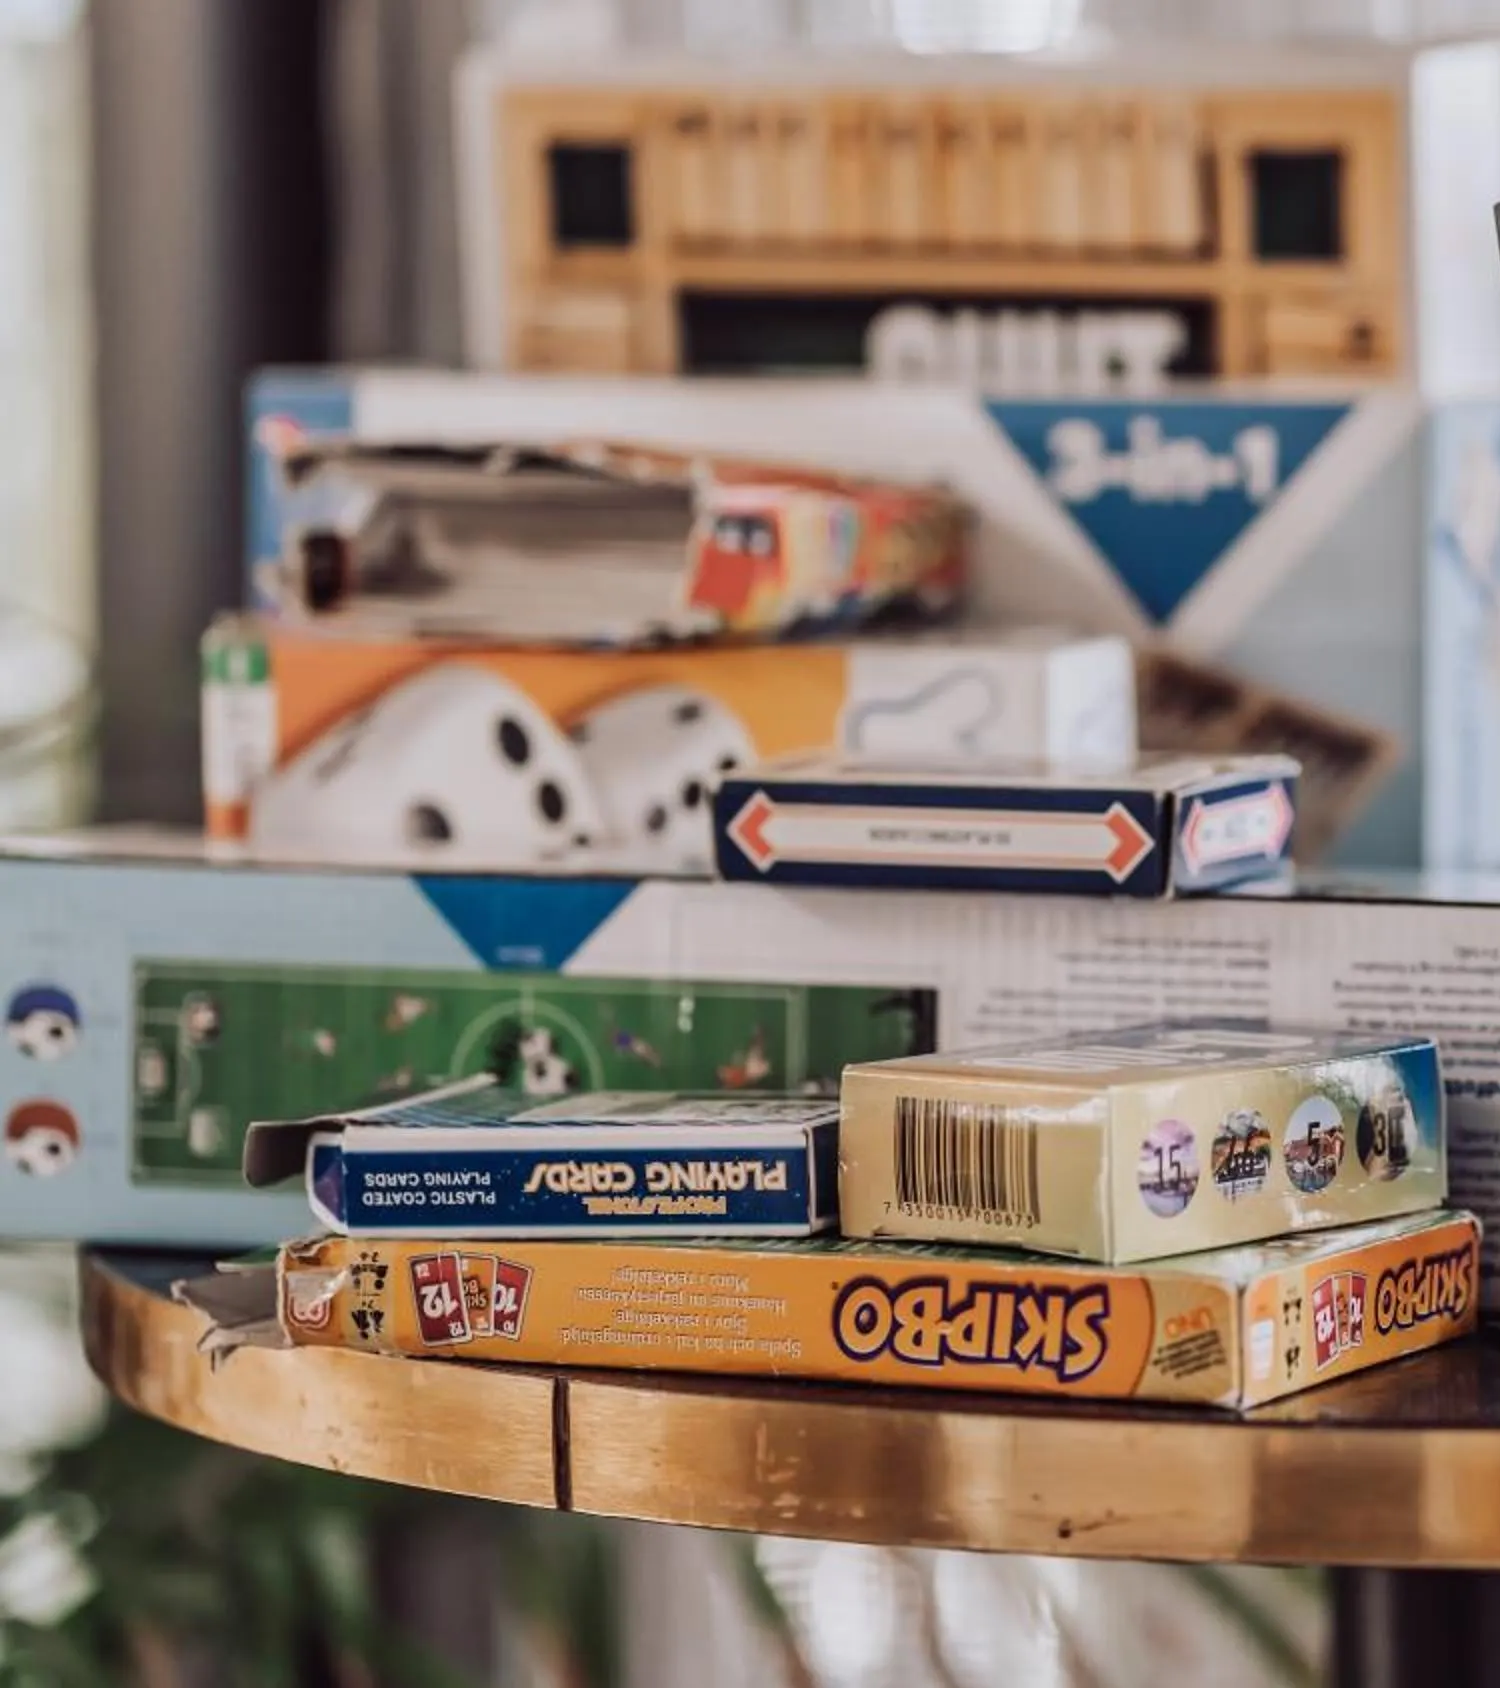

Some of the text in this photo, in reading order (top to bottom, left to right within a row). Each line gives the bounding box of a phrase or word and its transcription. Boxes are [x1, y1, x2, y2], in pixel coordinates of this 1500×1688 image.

[1046, 414, 1280, 503] 3-in-1
[364, 1171, 491, 1186] PLAYING CARDS
[524, 1161, 788, 1193] PLAYING CARDS
[362, 1190, 496, 1206] PLASTIC COATED
[420, 1282, 459, 1318] 12
[465, 1293, 487, 1309] SKI
[495, 1283, 518, 1315] 10
[833, 1277, 1109, 1382] SKIP-BO
